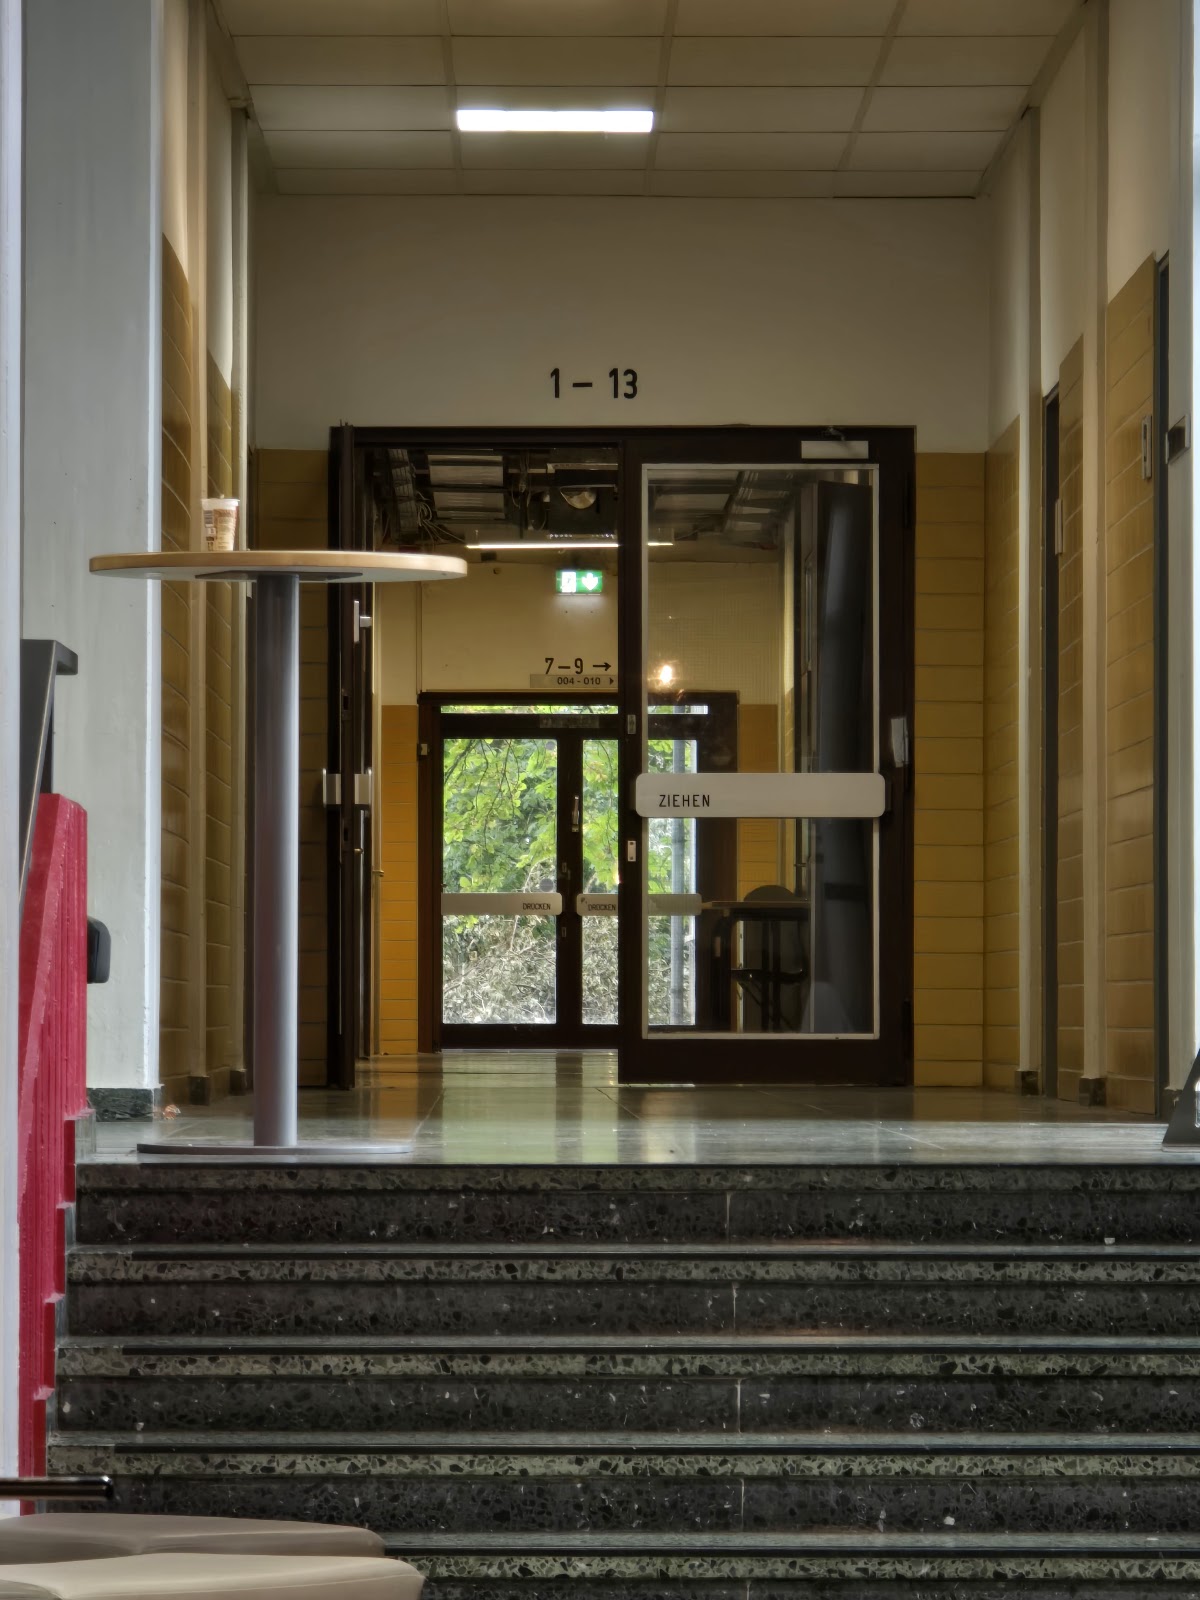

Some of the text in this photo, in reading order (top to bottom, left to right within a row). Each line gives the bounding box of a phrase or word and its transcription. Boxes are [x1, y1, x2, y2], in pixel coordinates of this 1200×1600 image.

[550, 367, 560, 398] 1
[608, 367, 638, 399] 13
[557, 676, 575, 685] 004
[583, 676, 601, 685] 010
[659, 794, 710, 807] ZIEHEN
